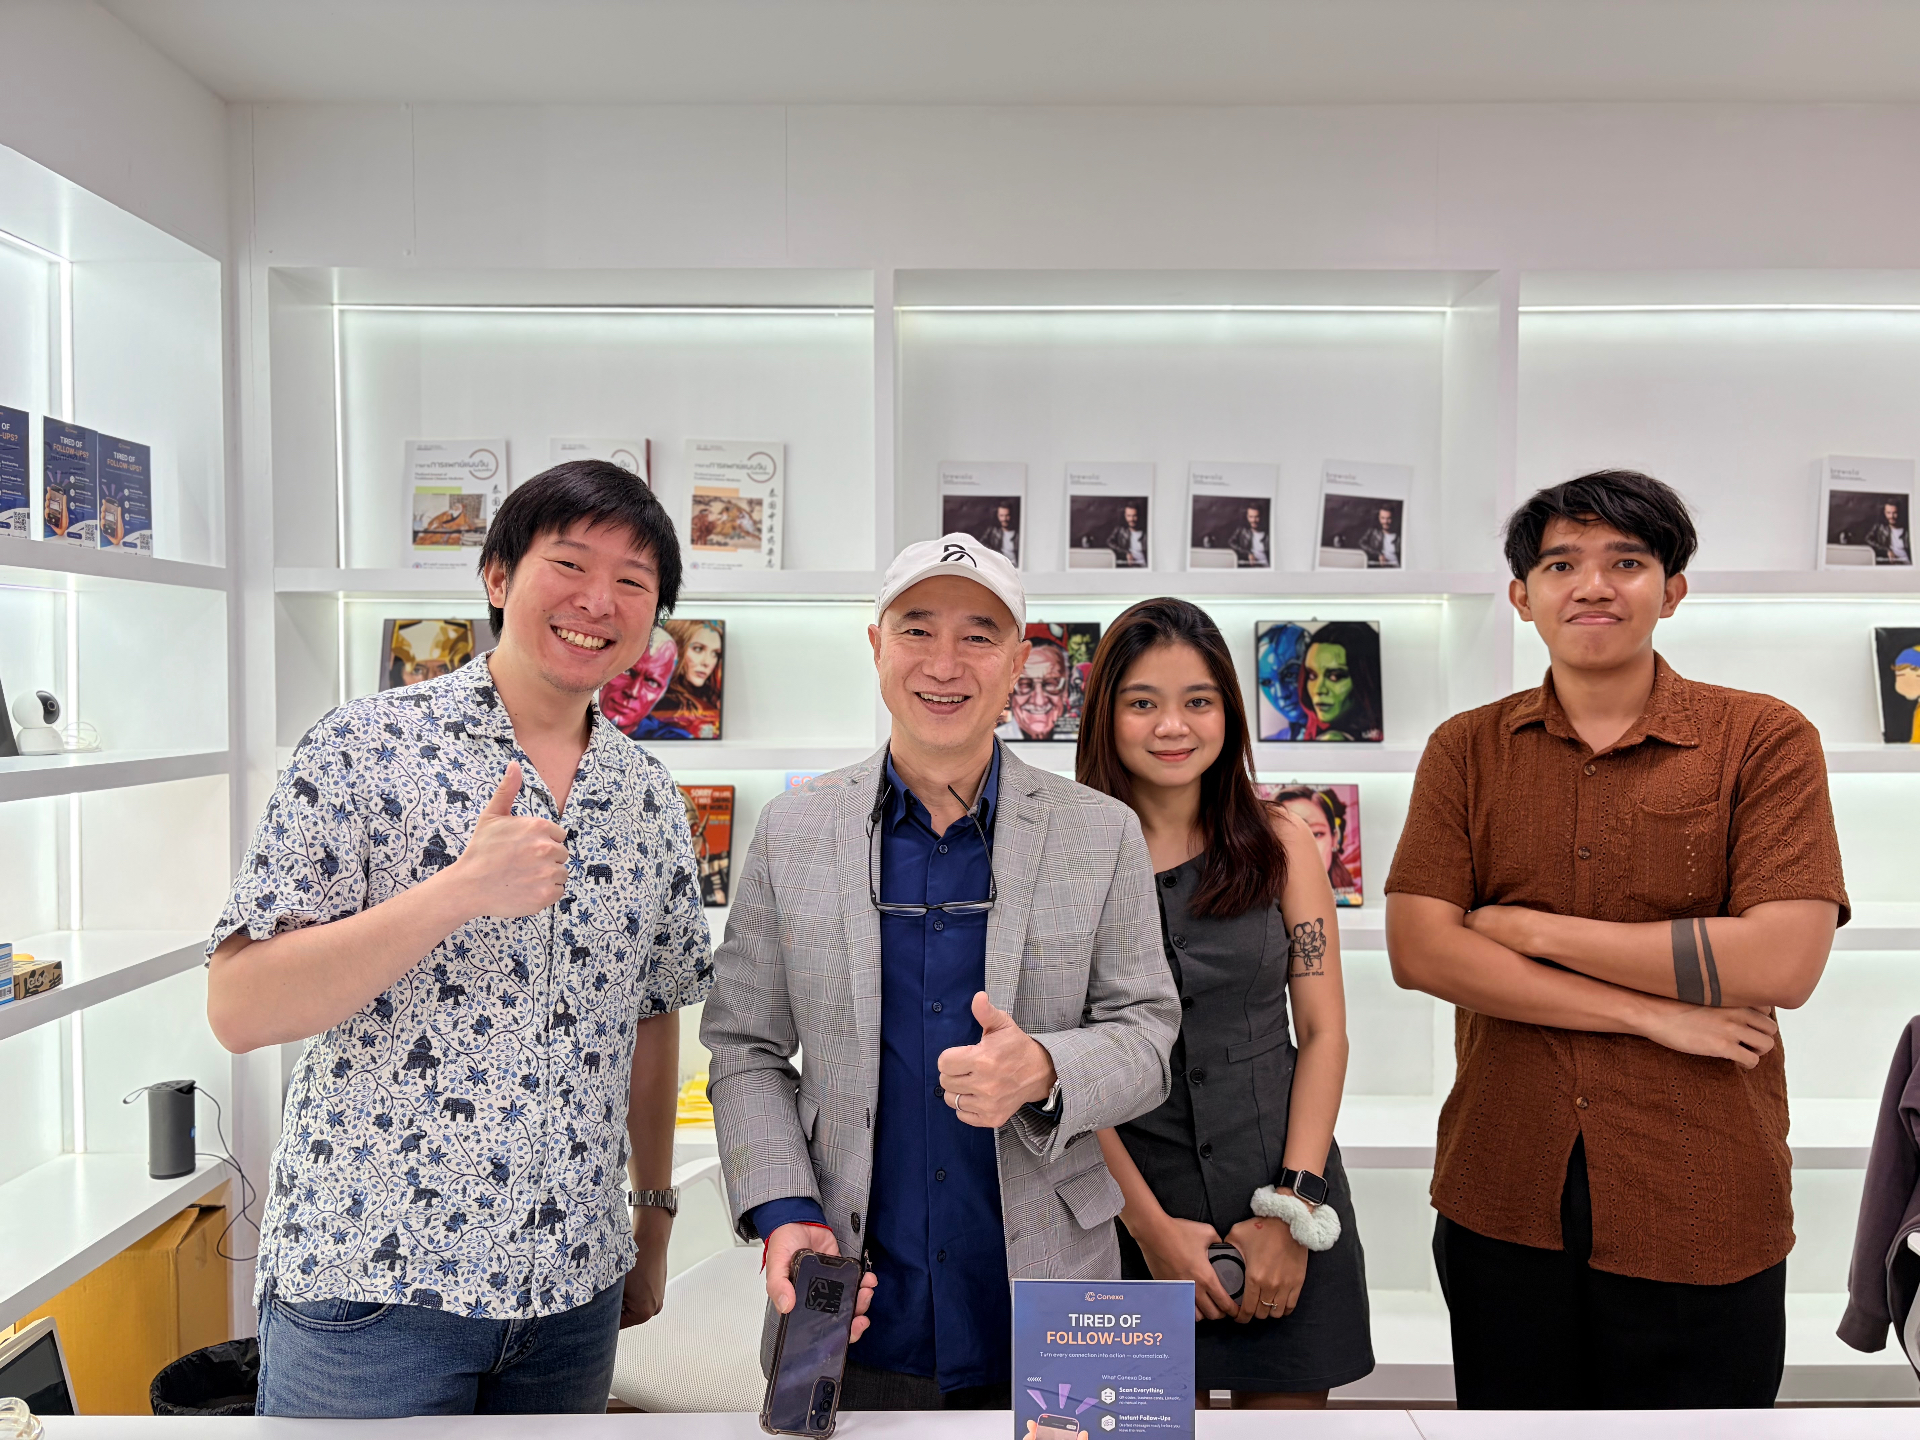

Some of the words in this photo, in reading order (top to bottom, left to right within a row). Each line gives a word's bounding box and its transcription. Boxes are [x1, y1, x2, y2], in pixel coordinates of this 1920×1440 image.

[2, 422, 10, 430] OF
[60, 436, 75, 446] TIRED
[53, 444, 89, 458] FOLLOW-UPS?
[114, 452, 128, 461] TIRED
[107, 459, 142, 472] FOLLOW-UPS?
[1096, 1293, 1124, 1301] Conexa
[1068, 1314, 1115, 1327] TIRED
[1119, 1315, 1141, 1328] OF
[1047, 1331, 1163, 1346] FOLLOW-UPS?
